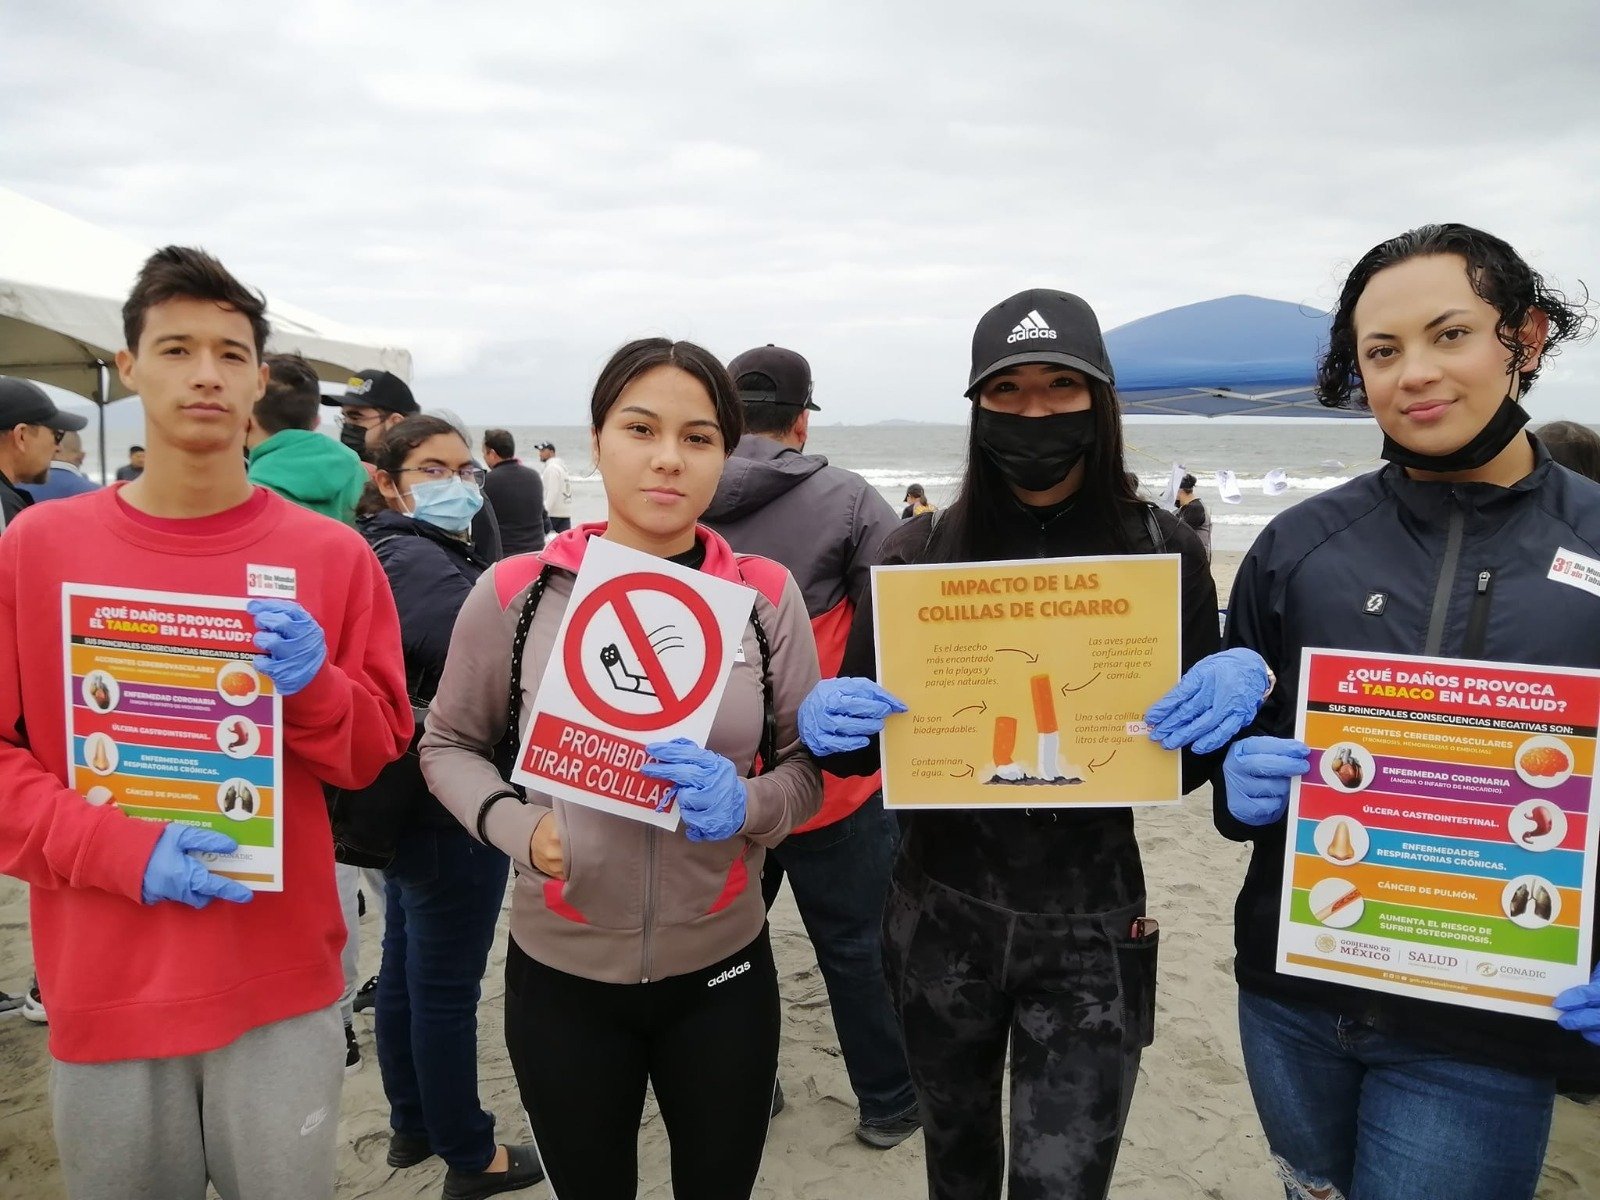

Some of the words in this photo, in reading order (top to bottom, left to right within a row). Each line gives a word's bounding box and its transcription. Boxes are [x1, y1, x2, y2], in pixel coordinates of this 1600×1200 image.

[1007, 327, 1057, 344] adidas
[941, 577, 1028, 596] IMPACTO
[1033, 575, 1058, 592] DE
[1064, 573, 1099, 590] LAS
[95, 606, 127, 619] ¿QUÉ
[130, 608, 175, 624] DAÑOS
[178, 613, 243, 629] PROVOCA
[918, 602, 1004, 622] COLILLAS
[1010, 601, 1034, 618] DE
[1039, 598, 1130, 617] CIGARRO
[89, 618, 104, 629] EL
[106, 619, 159, 635] TABACO
[161, 625, 178, 636] EN
[181, 627, 200, 638] LA
[201, 628, 252, 643] SALUD?
[84, 637, 97, 645] SUS
[97, 638, 141, 650] PRINCIPALES
[141, 643, 199, 655] CONSECUENCIAS
[200, 649, 240, 659] NEGATIVAS
[934, 644, 943, 653] Es
[944, 643, 952, 652] el
[953, 643, 987, 652] desecho
[1088, 637, 1102, 646] Las
[1104, 637, 1123, 645] aves
[1125, 636, 1158, 646] pueden
[926, 656, 944, 664] más
[946, 655, 994, 663] encontrado
[1092, 648, 1142, 658] confundirlo
[1144, 647, 1153, 656] al
[946, 667, 953, 675] la
[955, 667, 982, 677] playas
[983, 667, 990, 676] y
[1093, 661, 1122, 670] pensar
[1124, 660, 1141, 669] que
[925, 679, 955, 688] parajes
[957, 677, 998, 686] naturales.
[1106, 671, 1141, 680] comida.
[1347, 668, 1392, 682] ¿QUÉ
[1396, 671, 1459, 688] DAÑOS
[1464, 677, 1555, 696] PROVOCA
[1338, 681, 1358, 694] EL
[1362, 683, 1435, 701] TABACO
[1439, 690, 1463, 703] EN
[1468, 693, 1492, 706] LA
[1495, 695, 1567, 713] SALUD?
[912, 715, 926, 723] No
[927, 715, 941, 723] son
[1075, 713, 1093, 721] Una
[1094, 712, 1112, 721] sola
[1114, 712, 1139, 721] colilla
[1328, 704, 1347, 713] SUS
[1348, 706, 1408, 719] PRINCIPALES
[1410, 711, 1491, 727] CONSECUENCIAS
[1493, 720, 1548, 732] NEGATIVAS
[1549, 725, 1574, 735] SON:
[1075, 724, 1126, 733] contaminar
[1075, 735, 1096, 744] litros
[1098, 735, 1108, 743] de
[1111, 736, 1135, 745] agua.
[1342, 725, 1401, 737] ACCIDENTES
[1403, 731, 1513, 749] CEREBROVASCULARES
[124, 760, 178, 772] RESPIRATORIAS
[141, 754, 199, 766] ENFERMEDADES
[529, 745, 584, 783] TIRAR
[911, 757, 963, 766] Contaminan
[911, 769, 920, 777] el
[1382, 766, 1449, 781] ENFERMEDAD
[1451, 774, 1510, 787] CORONARIA
[1390, 777, 1417, 785] (ANGINA
[1424, 781, 1451, 789] INFARTO
[1462, 785, 1503, 794] MIOCARDIO).
[155, 790, 165, 798] DE
[1362, 805, 1400, 817] ÚLCERA
[1402, 810, 1499, 828] GASTROINTESTINAL.
[1402, 842, 1480, 858] ENFERMEDADES
[1376, 848, 1452, 864] RESPIRATORIAS
[1454, 857, 1507, 871] CRÓNICAS.
[1377, 881, 1416, 893] CÁNCER
[1419, 886, 1432, 895] DE
[1434, 888, 1478, 900] PULMÓN.
[1379, 913, 1426, 926] AUMENTA
[1427, 920, 1439, 928] EL
[1441, 921, 1476, 933] RIESGO
[1478, 927, 1492, 935] DE
[1380, 922, 1414, 934] SUFRIR
[1416, 927, 1492, 945] OSTEOPOROSIS.
[1340, 939, 1379, 951] GOBIERNO
[1340, 945, 1390, 961] MÉXICO
[1408, 951, 1458, 967] SALUD
[707, 961, 751, 987] adidas
[1500, 965, 1546, 979] CONADIC
